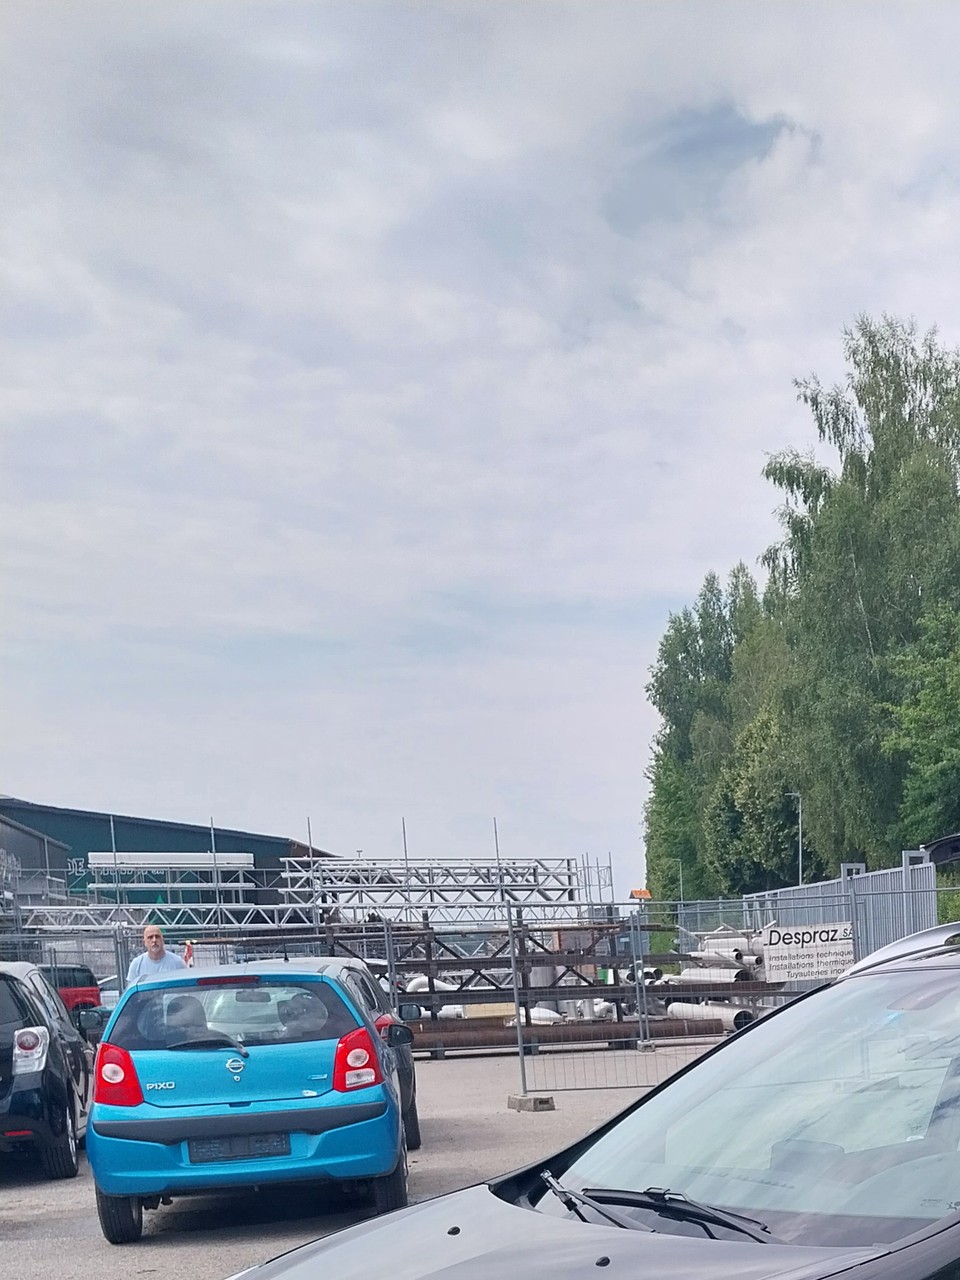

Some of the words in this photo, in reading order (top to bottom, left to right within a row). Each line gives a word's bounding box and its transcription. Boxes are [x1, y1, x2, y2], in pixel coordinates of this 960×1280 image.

[769, 929, 838, 948] Despraz
[769, 952, 814, 961] Installations
[769, 961, 814, 970] Installations
[830, 968, 845, 976] inox
[146, 1081, 175, 1090] PIXO
